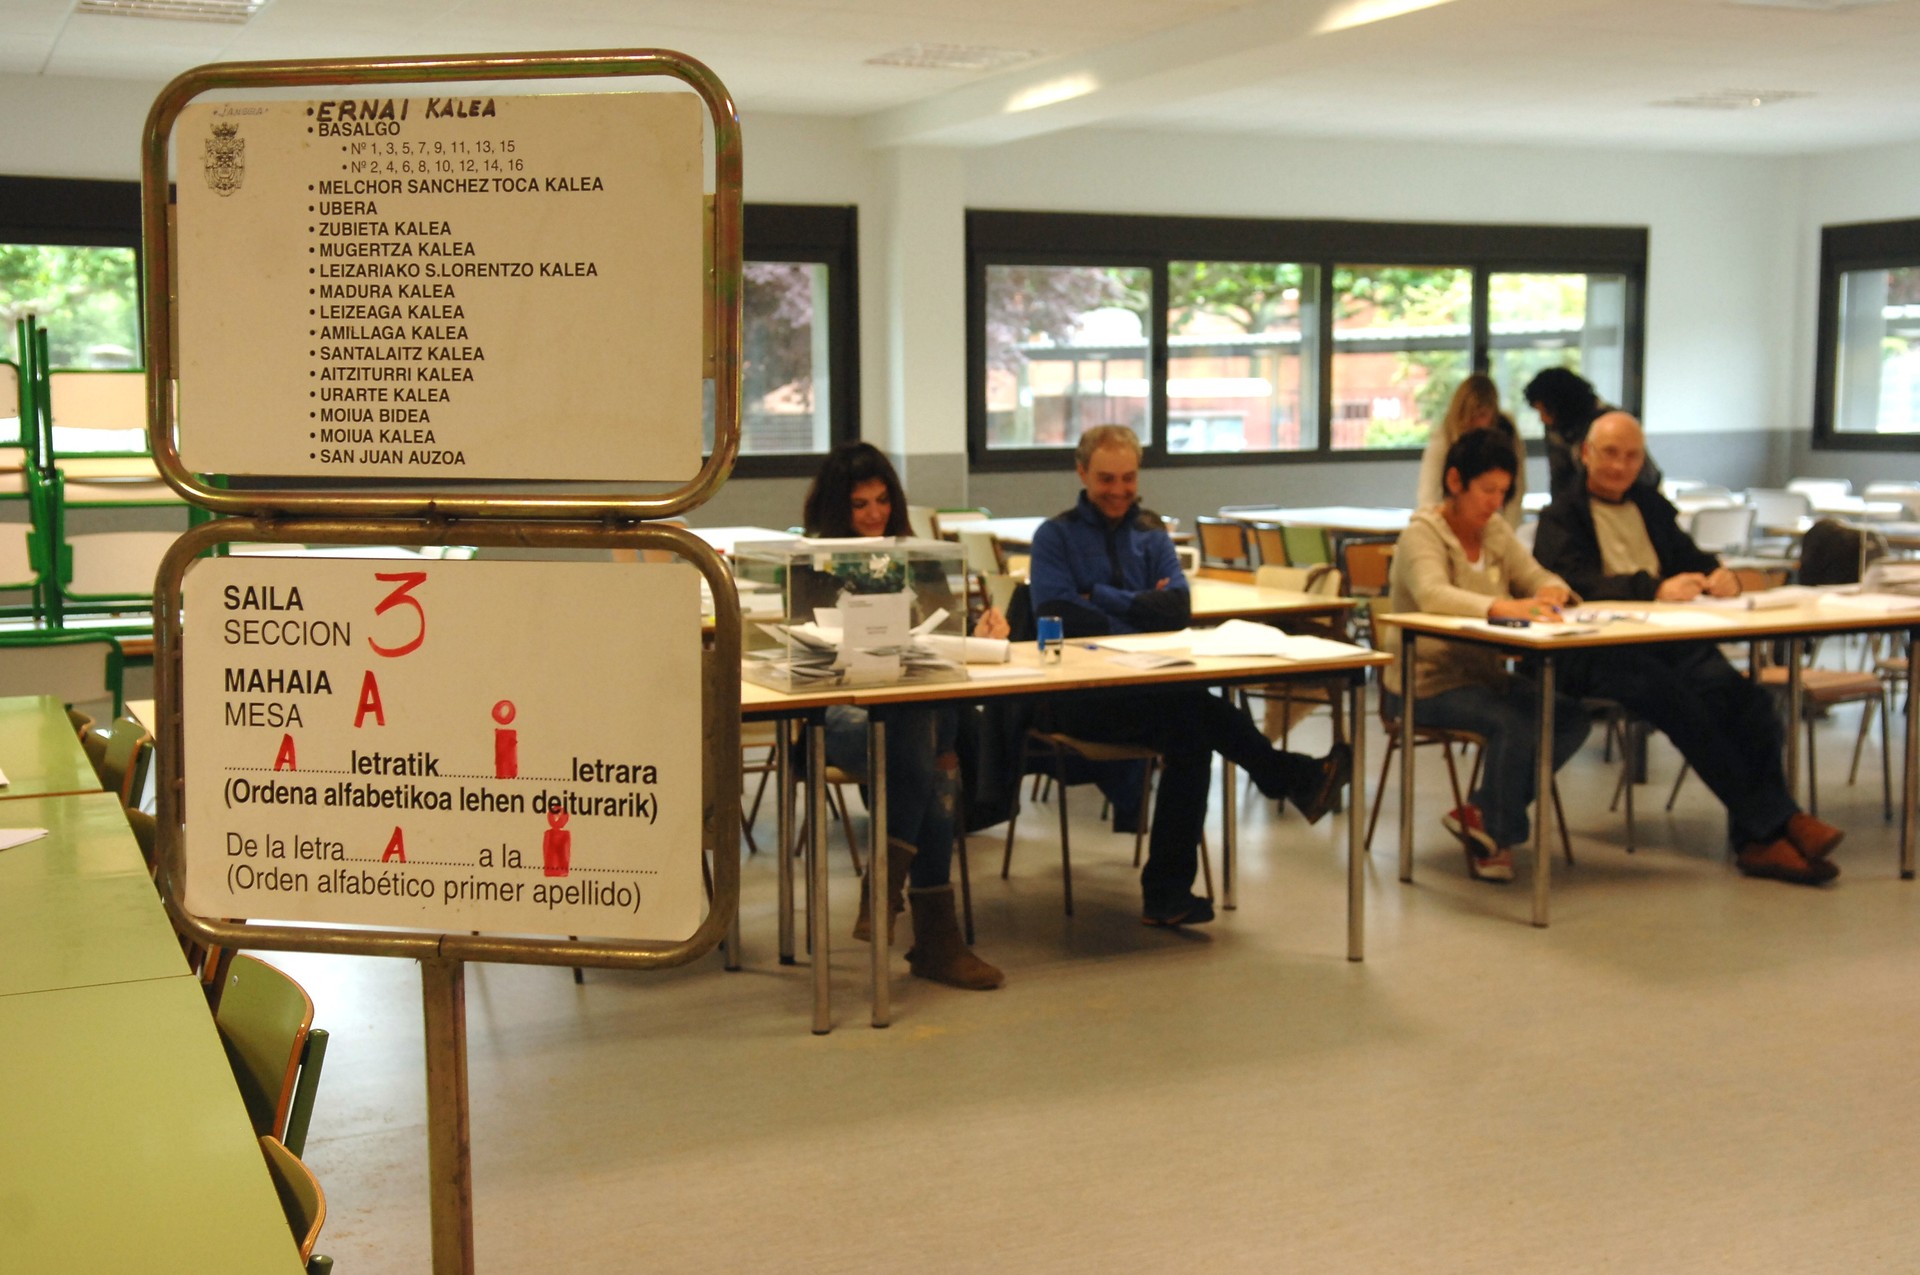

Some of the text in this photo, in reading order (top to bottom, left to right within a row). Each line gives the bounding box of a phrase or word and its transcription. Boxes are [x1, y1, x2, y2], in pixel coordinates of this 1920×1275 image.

[317, 97, 496, 121] ERNAI KALEA
[318, 121, 400, 137] BASALGO
[351, 140, 515, 156] Nº 1, 3, 5, 7, 9, 11, 13, 15
[352, 159, 523, 175] Nº 2, 4, 6, 8, 10, 12, 14, 16
[319, 177, 603, 194] MELCHOR SANCHEZ TOCA KALEA
[320, 201, 378, 216] UBERA
[319, 221, 451, 237] ZUBIETA KALEA
[320, 242, 475, 257] MUGERTZA KALEA
[320, 262, 598, 279] LEIZARIAKO S.LORENTZO KALEA
[320, 284, 455, 299] MADURA KALEA
[320, 305, 464, 319] LEIZEAGA KALEA
[320, 325, 468, 340] AMILLAGA KALEA
[320, 346, 485, 361] SANTALAITZ KALEA
[320, 367, 474, 382] AITZITURRI KALEA
[321, 387, 450, 402] URARTE KALEA
[321, 408, 430, 423] MOIUA BIDEA
[321, 428, 436, 444] MOIUA KALEA
[320, 449, 465, 465] SAN JUAN AUZOA
[224, 585, 304, 611] SAILA
[368, 572, 427, 657] 3
[224, 619, 350, 646] SECCION
[225, 668, 332, 694] MAHAIA
[354, 670, 385, 728] A
[225, 702, 303, 728] MESA
[273, 733, 297, 772] A
[224, 778, 658, 825] (Ordena alfabetikoa lehen deiturarik)
[227, 832, 258, 857] De
[266, 834, 286, 859] la
[382, 826, 407, 864] A
[479, 849, 494, 868] a
[502, 844, 522, 869] la
[228, 864, 640, 914] (Orden alfabético primer apellido)
